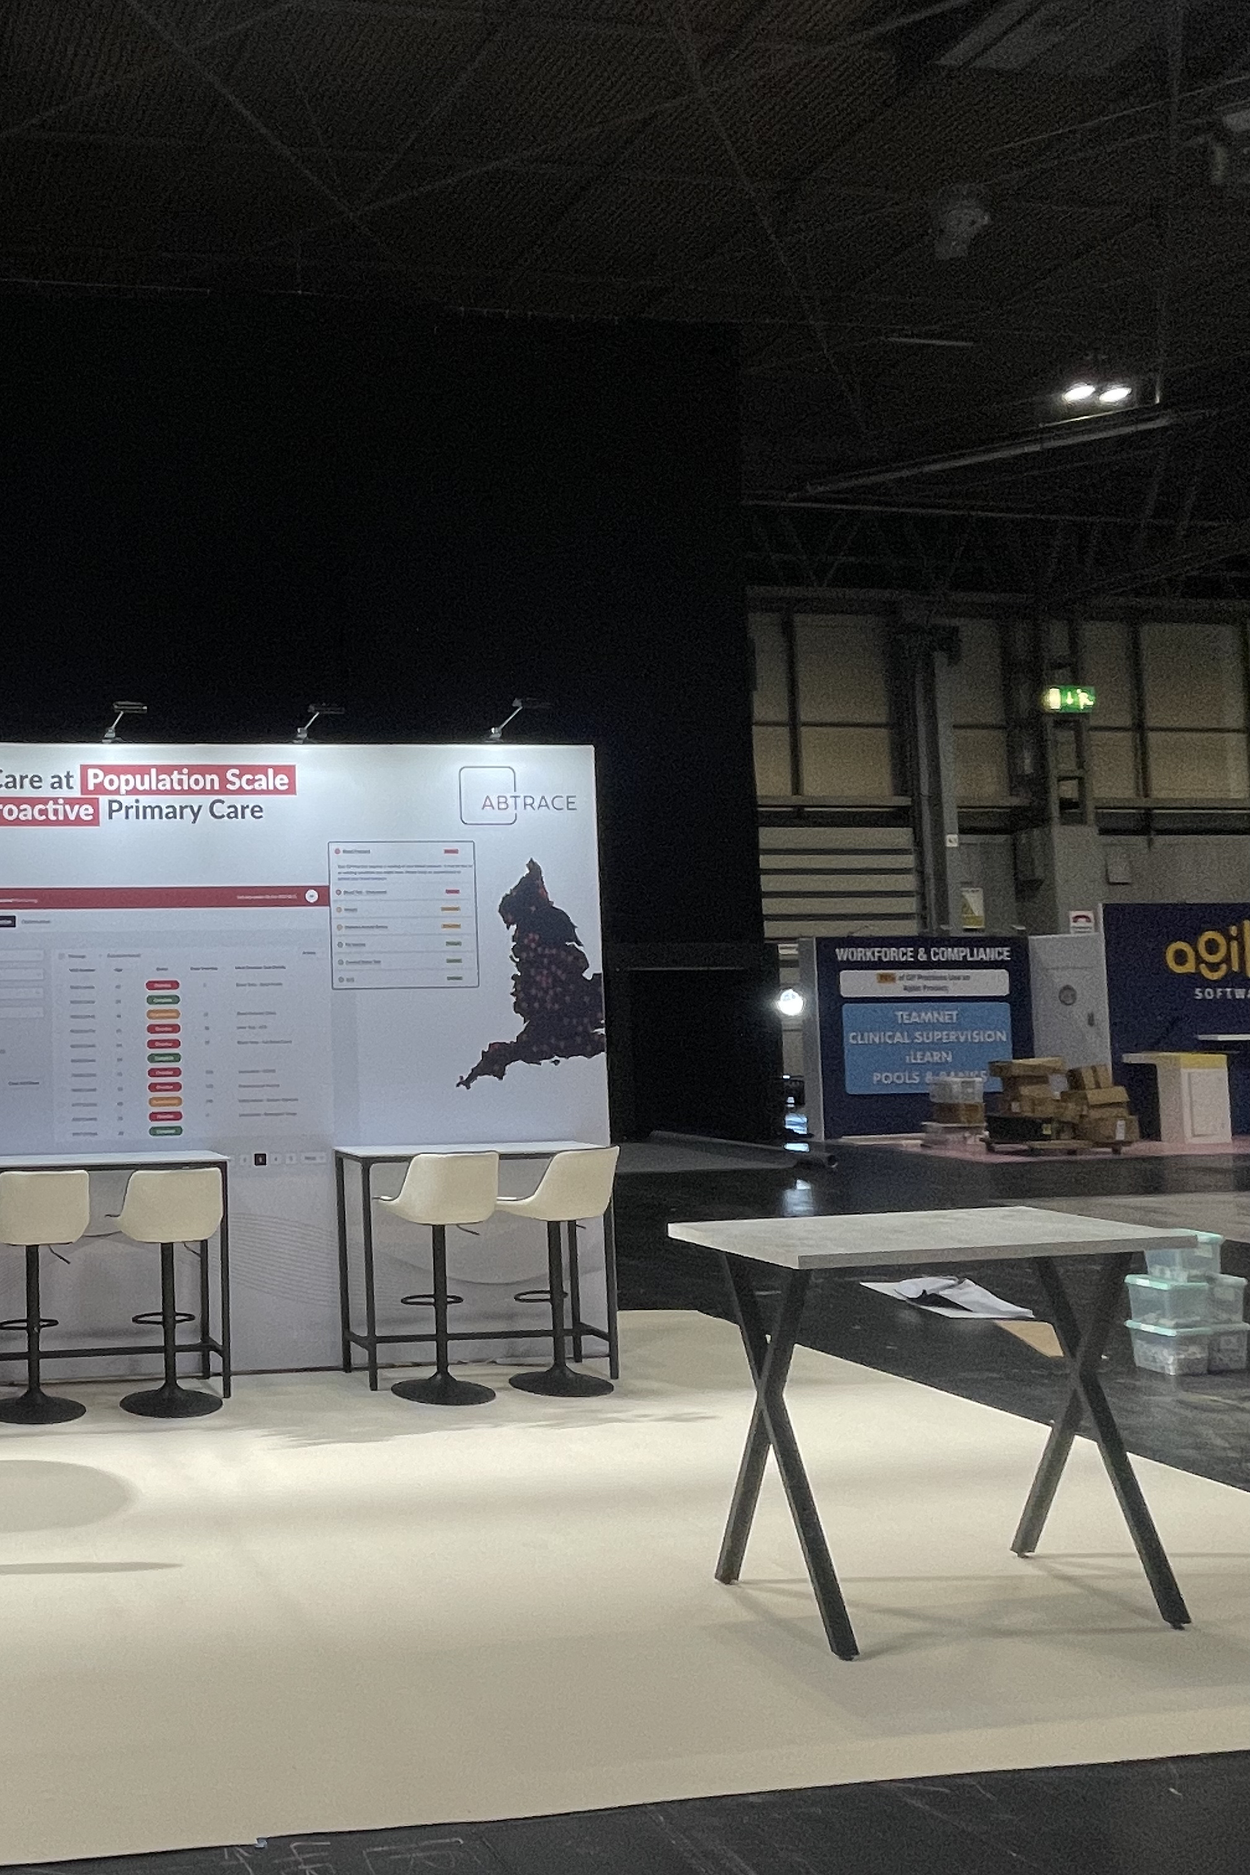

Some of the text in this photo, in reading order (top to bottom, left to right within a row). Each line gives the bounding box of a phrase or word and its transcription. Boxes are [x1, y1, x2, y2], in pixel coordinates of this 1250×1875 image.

[50, 769, 74, 790] at
[86, 768, 219, 795] Population
[226, 768, 289, 791] Scale
[481, 794, 578, 811] ABTRACE
[108, 799, 203, 824] Primary
[209, 799, 264, 820] Care
[836, 947, 1011, 961] WORKFORCE & COMPLIANCE
[895, 1011, 958, 1024] TEAMNET
[849, 1030, 1007, 1044] CLINICAL SUPERVISION
[873, 1071, 920, 1084] POOLS
